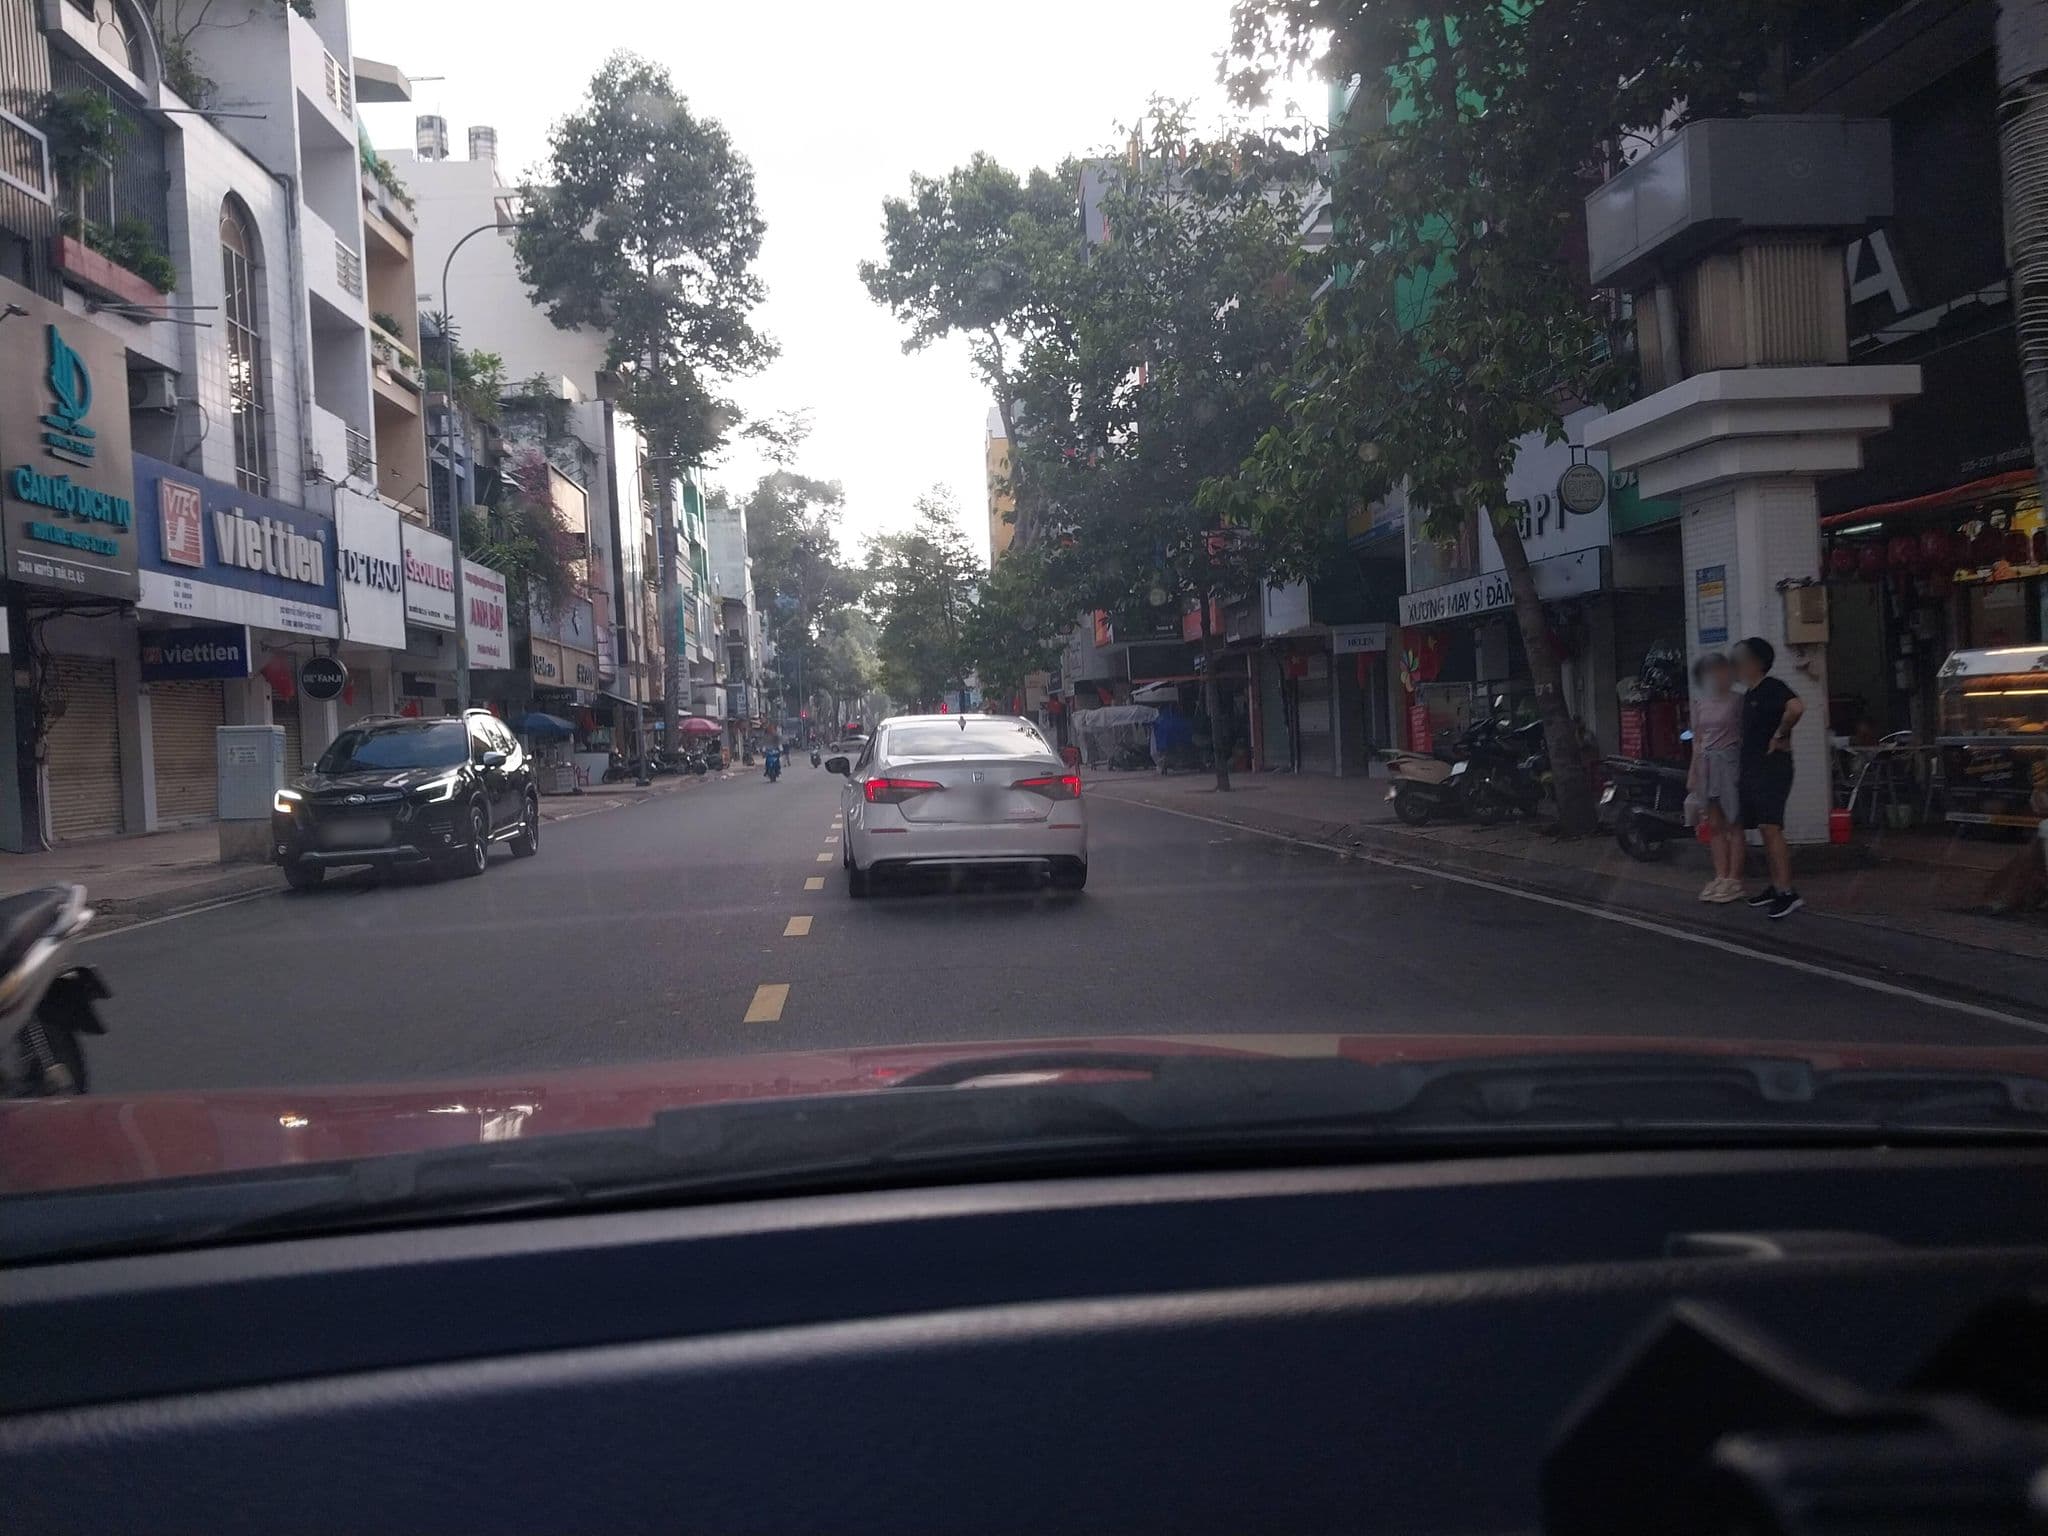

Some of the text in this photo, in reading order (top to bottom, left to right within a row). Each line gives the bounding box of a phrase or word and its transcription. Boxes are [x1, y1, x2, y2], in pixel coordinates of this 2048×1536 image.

[213, 507, 325, 587] viettien
[437, 567, 454, 592] LEN
[1447, 591, 1471, 613] MAY
[166, 643, 239, 664] viettien
